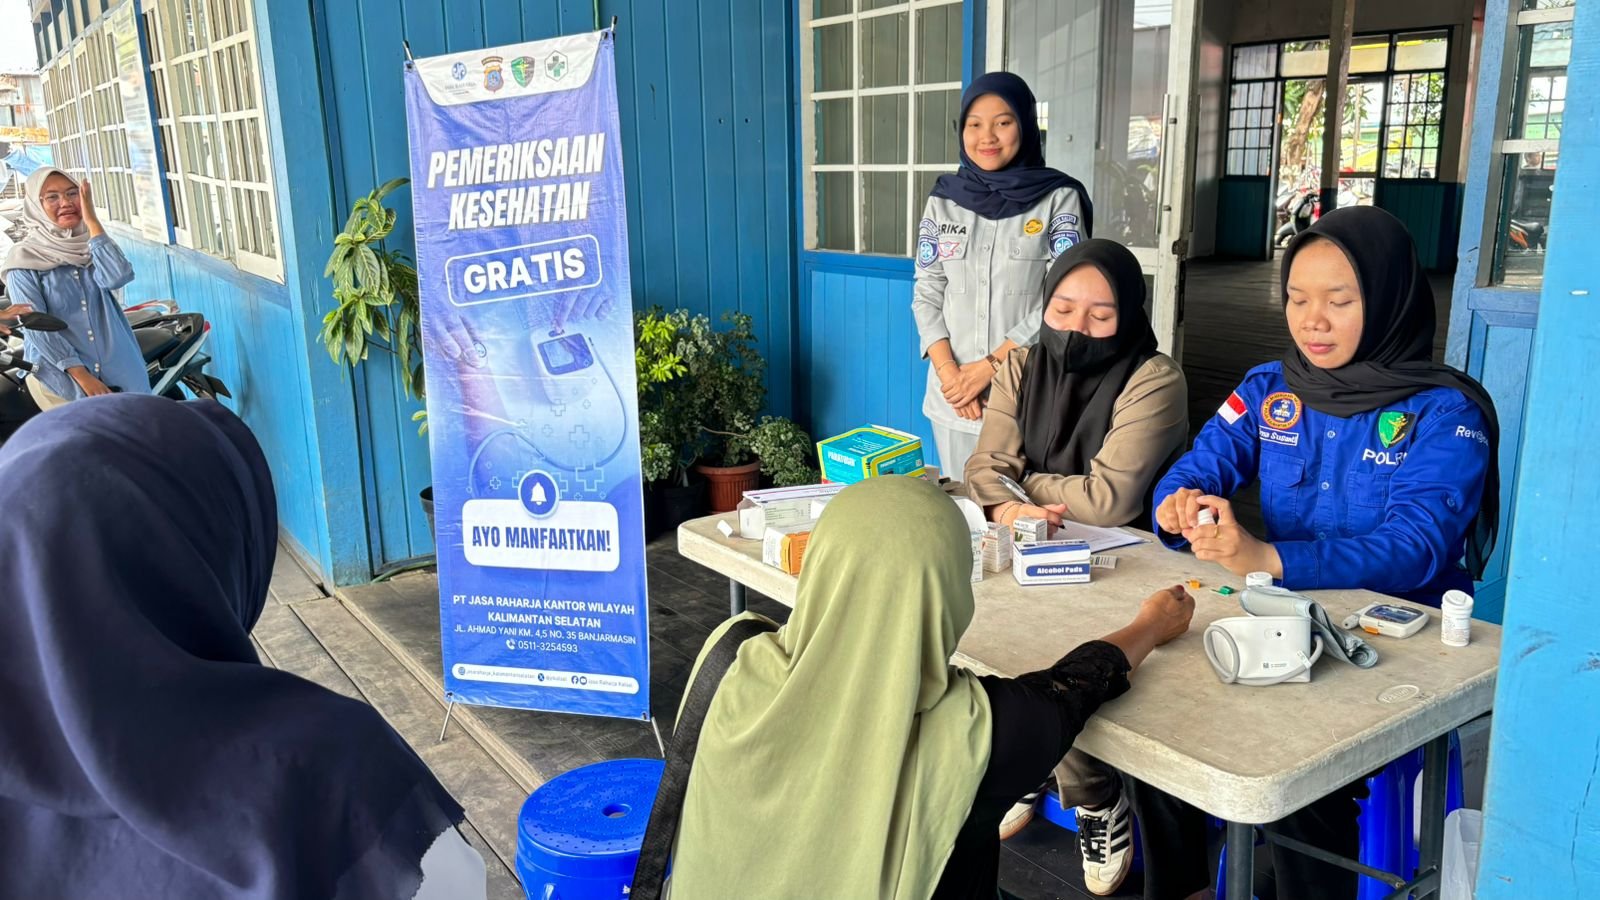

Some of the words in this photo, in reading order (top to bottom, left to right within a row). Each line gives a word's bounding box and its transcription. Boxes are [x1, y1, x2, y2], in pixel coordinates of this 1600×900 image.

[427, 132, 606, 189] PEMERIKSAAN
[448, 180, 591, 231] KESEHATAN
[463, 247, 586, 294] GRATIS
[472, 525, 500, 548] AYO
[505, 526, 611, 552] MANFAATKAN!
[1036, 566, 1065, 574] Alcohol
[453, 595, 467, 604] PT
[468, 596, 494, 606] JASA
[496, 598, 542, 609] RAHARJA
[543, 599, 586, 612] KANTOR
[587, 602, 635, 615] WILAYAH
[488, 611, 553, 625] KALIMANTAN
[554, 616, 602, 628] SELATAN
[454, 625, 466, 633] JL.
[467, 626, 497, 635] AHMAD
[498, 627, 517, 636] YANI
[518, 628, 533, 637] KM.
[535, 630, 548, 639] 4,5
[549, 630, 564, 639] NO.
[566, 631, 577, 640] 35
[578, 632, 636, 645] BANJARMASIN
[517, 640, 579, 653] 0511-3254593
